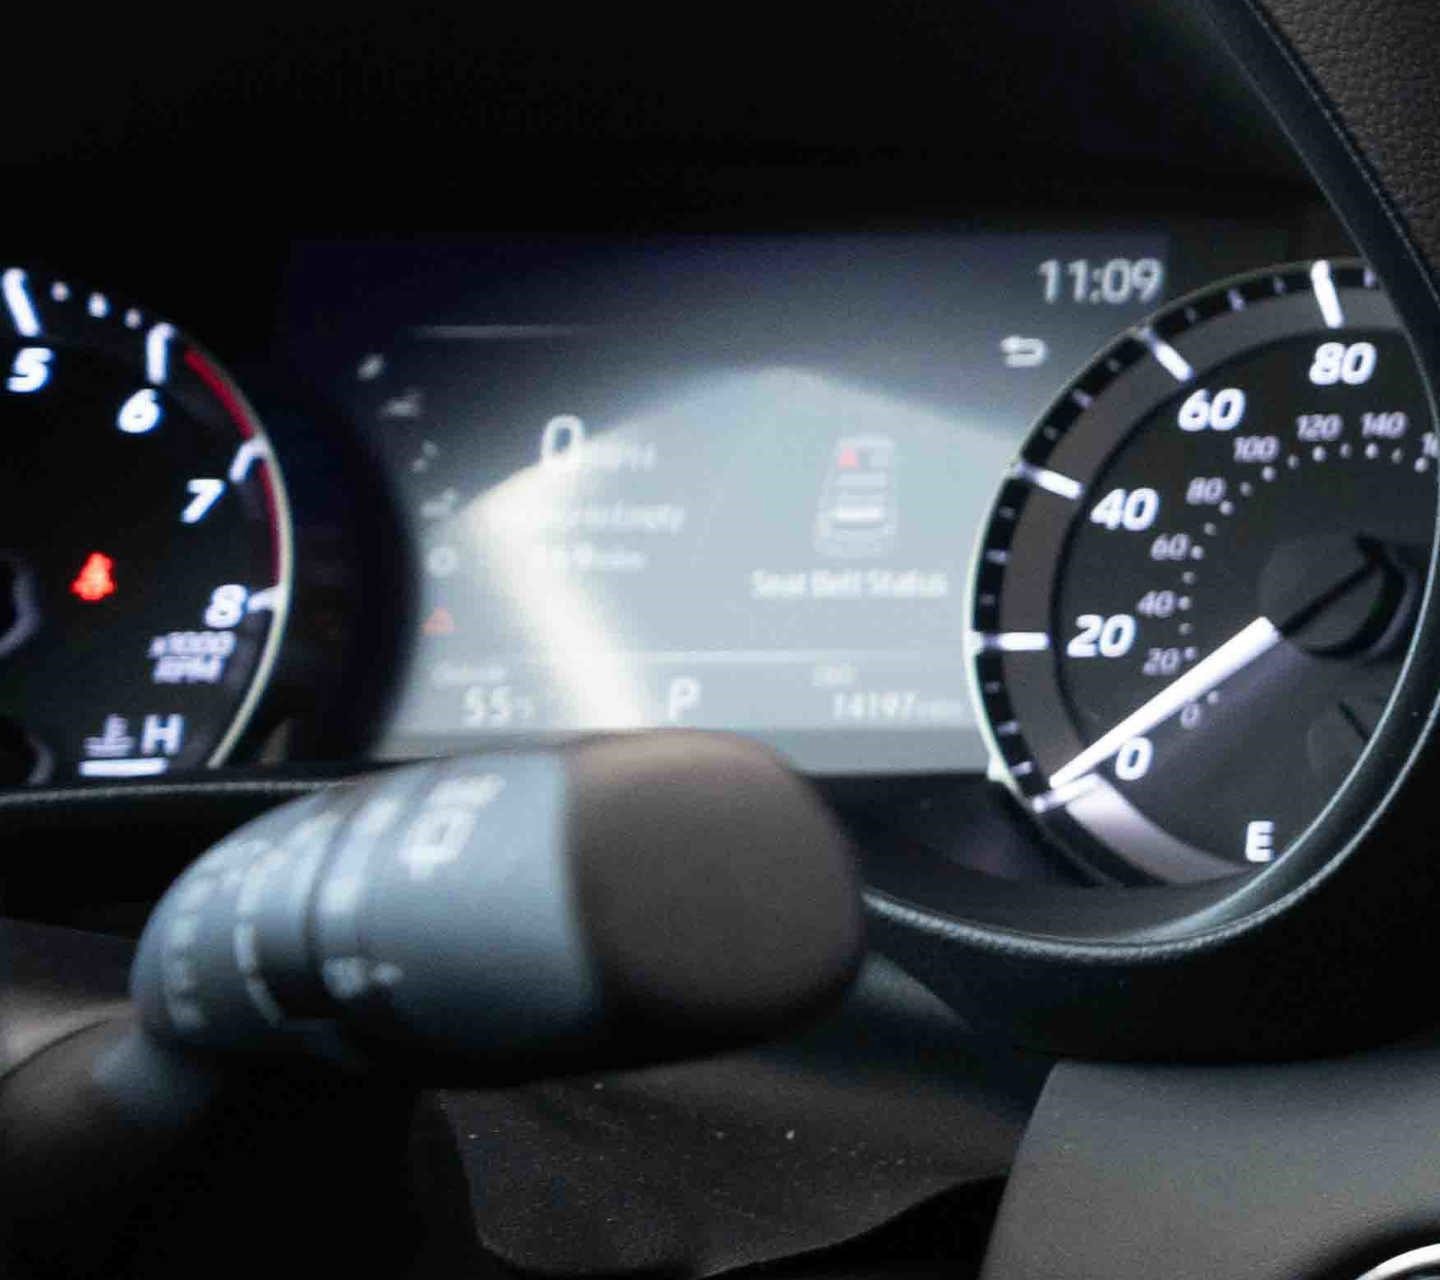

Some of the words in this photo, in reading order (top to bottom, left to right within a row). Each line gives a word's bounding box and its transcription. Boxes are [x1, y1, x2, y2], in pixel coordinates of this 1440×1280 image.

[1039, 259, 1162, 304] 11:09
[6, 347, 55, 394] 5
[1309, 343, 1377, 386] 80
[117, 389, 165, 434] 6
[1178, 388, 1245, 432] 60
[1297, 415, 1341, 440] 120
[1362, 411, 1409, 437] 140
[1233, 436, 1279, 463] 100
[180, 479, 225, 526] 7
[1091, 489, 1158, 531] 40
[1187, 478, 1223, 504] 80
[1150, 535, 1190, 562] 60
[204, 584, 249, 629] 8
[1136, 591, 1175, 618] 40
[1067, 616, 1136, 658] 20
[1143, 647, 1180, 676] 20
[668, 677, 702, 720] P
[141, 713, 184, 755] H
[1115, 737, 1154, 780] 0
[1246, 821, 1275, 863] E
